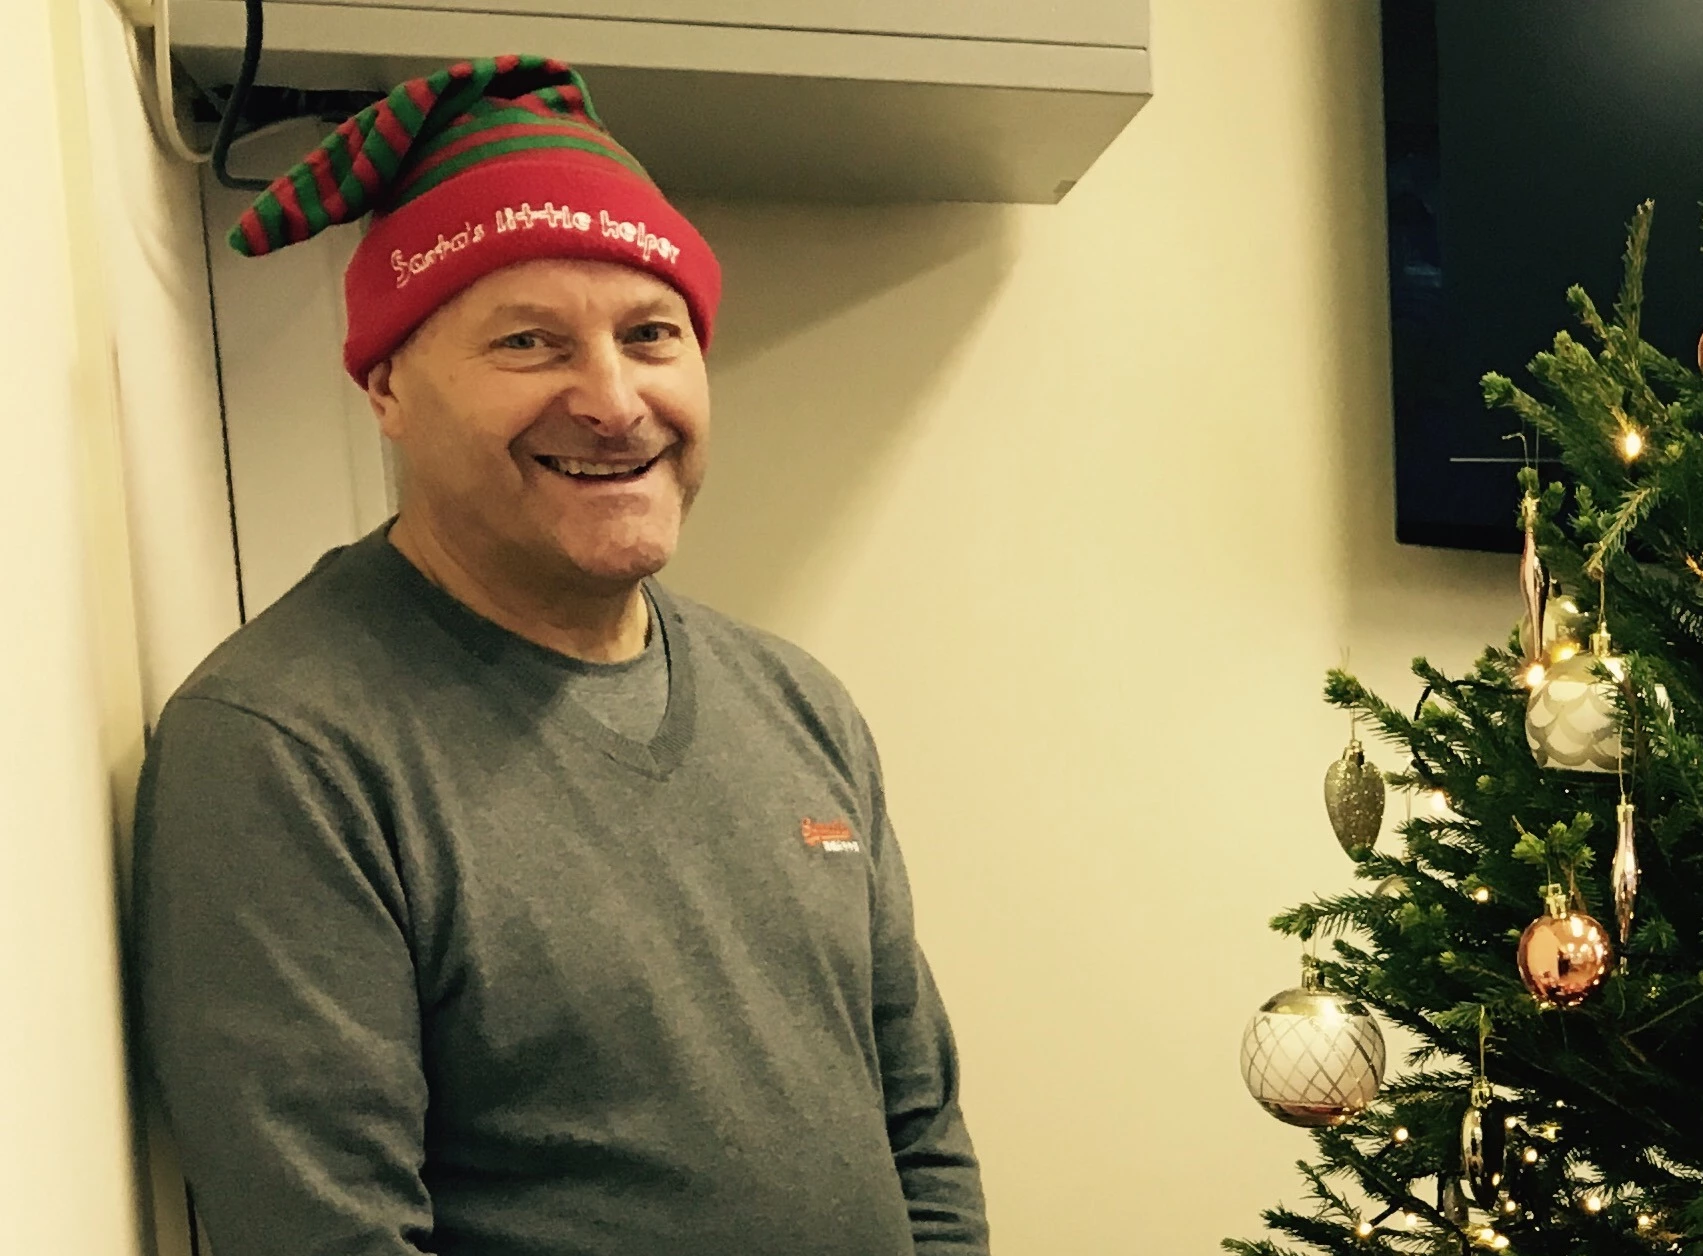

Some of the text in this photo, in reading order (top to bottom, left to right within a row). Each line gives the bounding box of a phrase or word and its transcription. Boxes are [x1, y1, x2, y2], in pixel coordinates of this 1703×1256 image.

[391, 202, 680, 288] Santa's little helper
